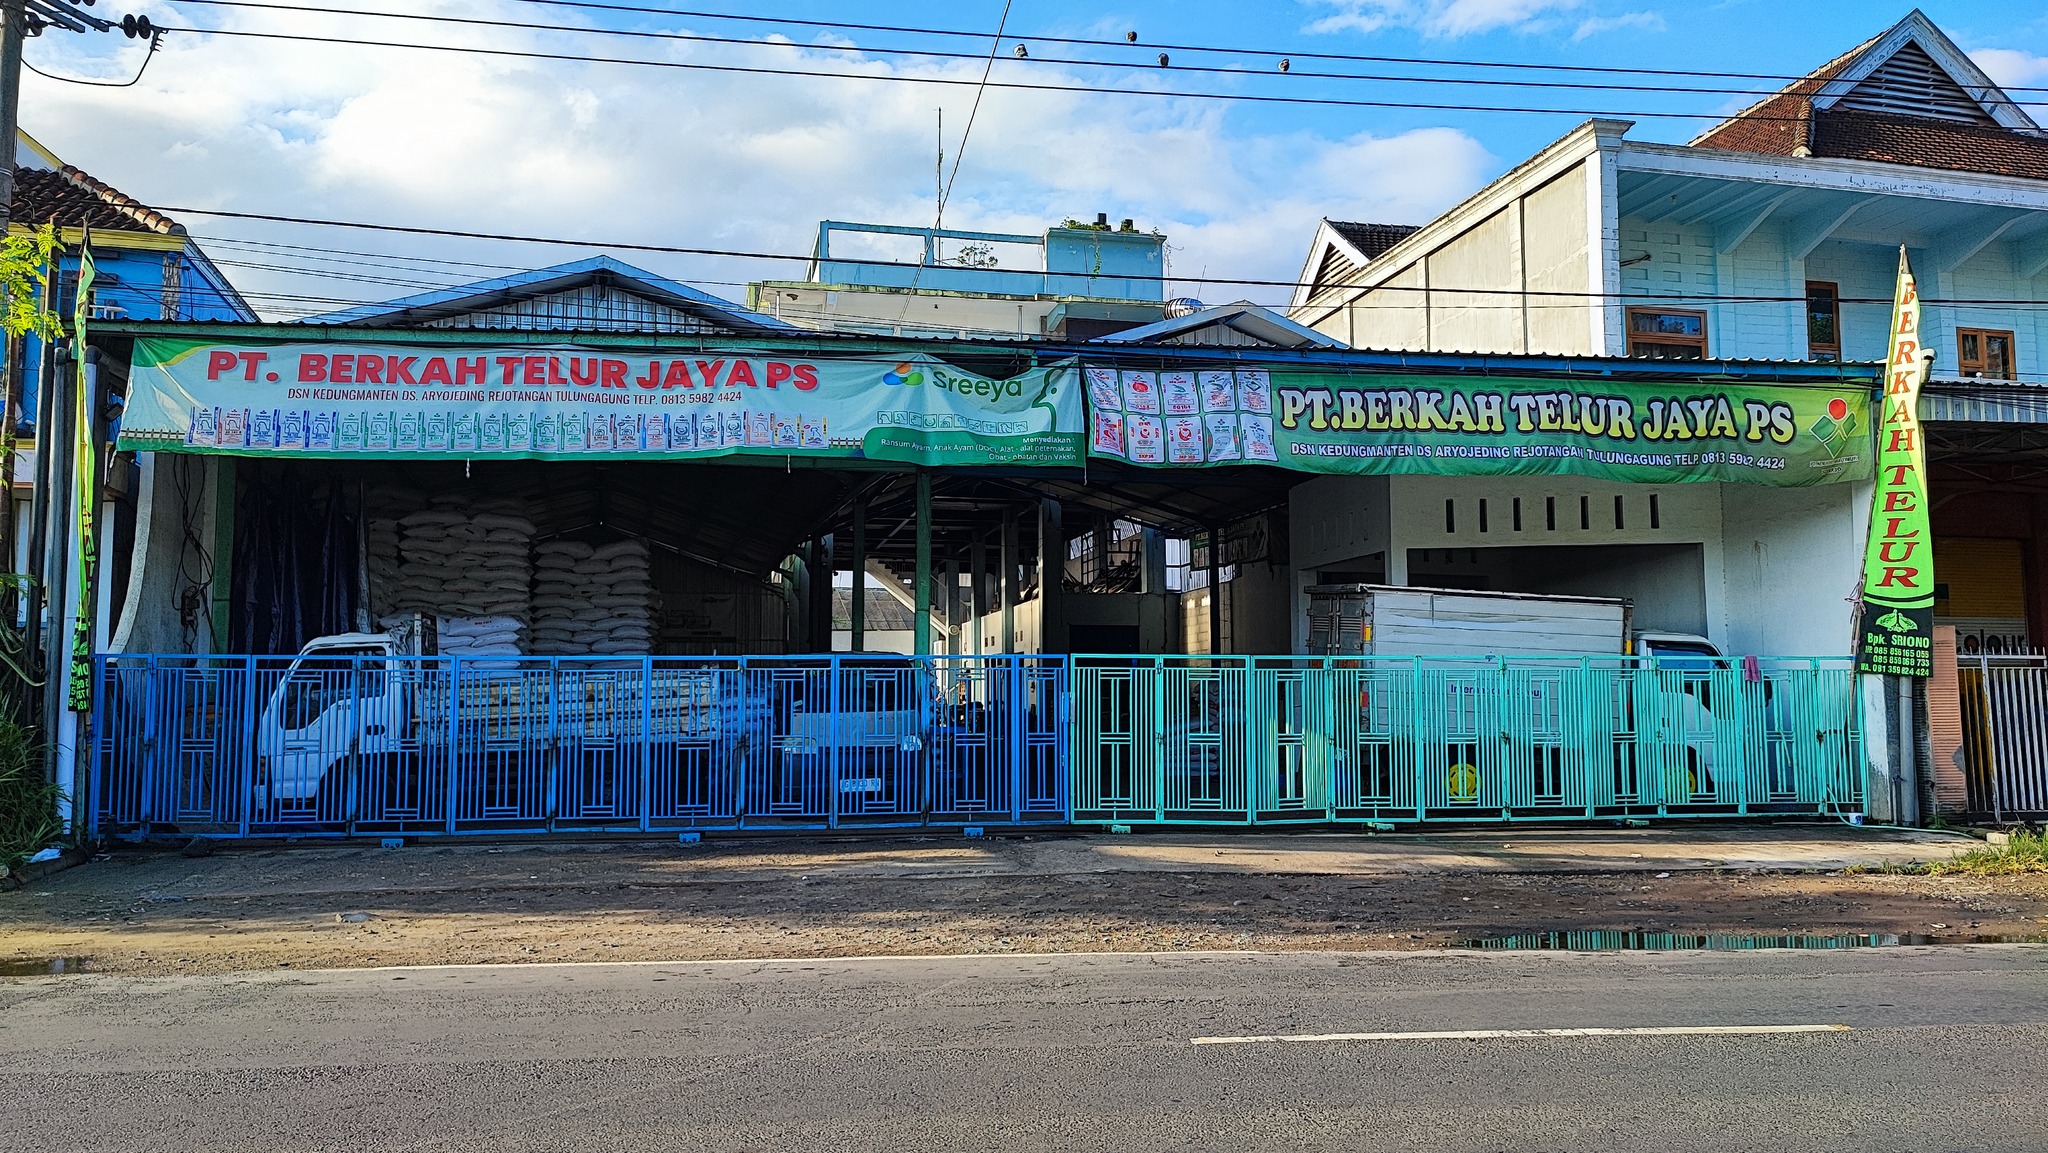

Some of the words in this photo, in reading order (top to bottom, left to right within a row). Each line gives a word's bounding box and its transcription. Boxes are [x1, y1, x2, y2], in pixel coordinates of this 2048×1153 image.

[207, 350, 281, 382] PT.
[297, 352, 487, 386] BERKAH
[495, 356, 629, 389] TELUR
[636, 358, 758, 391] JAYA
[766, 361, 820, 391] PS
[1885, 282, 1916, 453] BERKAH
[933, 370, 1022, 403] Sreeya
[287, 388, 310, 400] DSN
[313, 388, 400, 401] KEDUNGMANTEN
[402, 389, 418, 402] DS.
[421, 389, 485, 403] ARYOJEDING
[488, 390, 552, 403] REJOTANGAN
[555, 391, 630, 405] TULUNGAGUNG
[633, 393, 658, 405] TELP.
[661, 393, 686, 405] 0813
[689, 392, 714, 405] 5982
[717, 391, 742, 403] 4424
[1511, 393, 1636, 440] TELUR
[1643, 397, 1737, 441] JAYA
[1746, 402, 1795, 443] PS
[881, 438, 910, 449] Ransum
[933, 443, 953, 452] Anak
[954, 444, 974, 453] Ayam
[1000, 445, 1015, 453] Alat
[1020, 444, 1034, 452] alat
[1012, 453, 1038, 461] obatan
[1038, 453, 1053, 461] dan
[1053, 453, 1077, 461] Vaksin
[1291, 443, 1316, 455] DSN
[1318, 444, 1413, 457] KEDUNGMANTEN
[1416, 445, 1432, 457] DS
[1435, 445, 1510, 458] ARYOJEDING
[1513, 446, 1584, 458] REJOTANGAN
[1586, 448, 1671, 466] TULUNGAGUNG
[1701, 451, 1726, 464] 0813
[1756, 456, 1786, 469] 4424
[1874, 464, 1920, 588] TELUR
[1867, 632, 1887, 646] Bpk.
[1891, 634, 1930, 649] SRIONO
[1873, 646, 1888, 655] 085
[1902, 649, 1915, 657] 165
[1872, 655, 1888, 664] 085
[1889, 656, 1902, 665] 859
[1916, 659, 1930, 668] 733
[1872, 664, 1886, 673] 081
[1887, 666, 1900, 675] 359
[1915, 668, 1930, 677] 424
[1516, 686, 1546, 699] Goup
